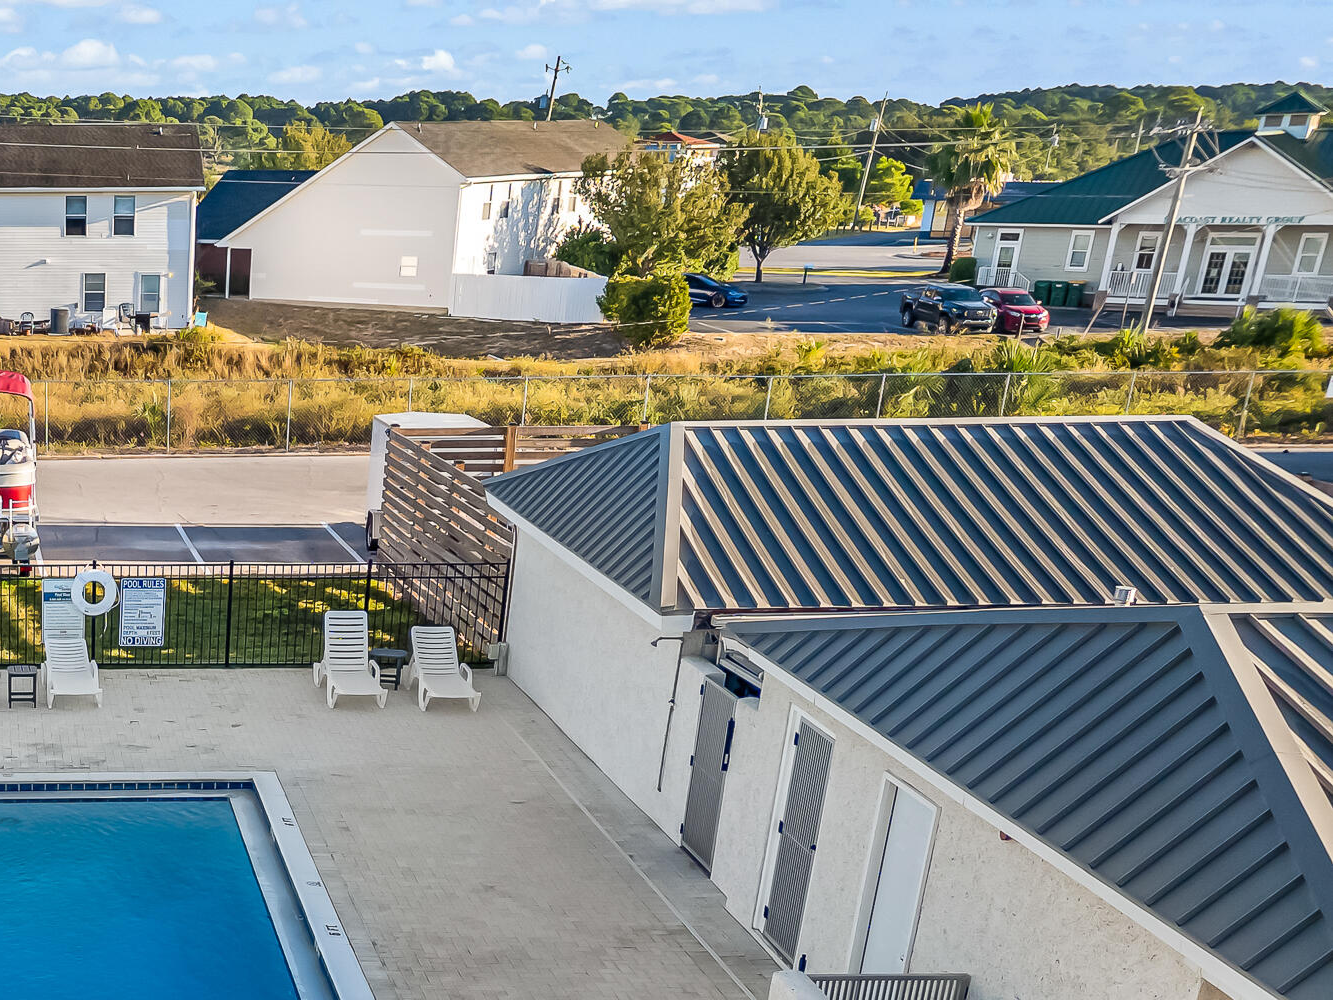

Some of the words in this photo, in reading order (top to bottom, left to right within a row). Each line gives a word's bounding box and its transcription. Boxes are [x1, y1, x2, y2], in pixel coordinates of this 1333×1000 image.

[123, 580, 141, 588] POOL
[142, 580, 164, 588] RULES
[122, 636, 133, 645] NO
[134, 636, 162, 645] DIVING
